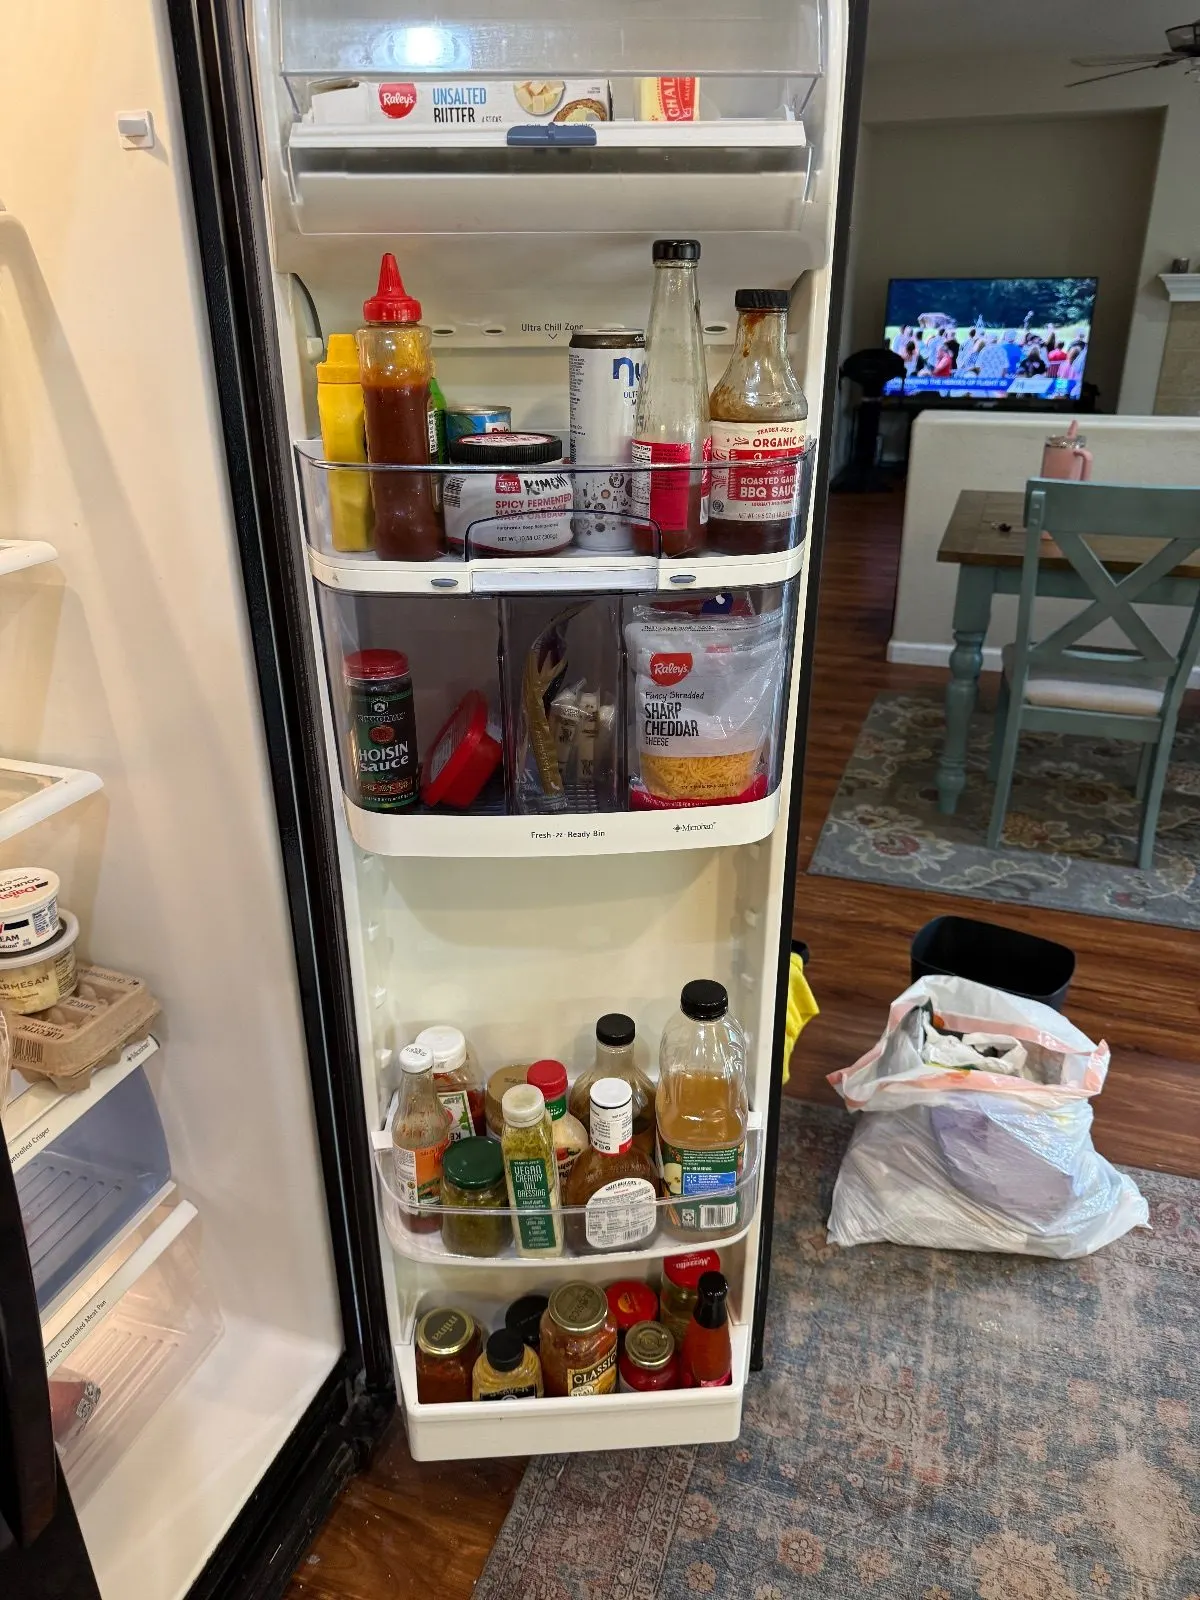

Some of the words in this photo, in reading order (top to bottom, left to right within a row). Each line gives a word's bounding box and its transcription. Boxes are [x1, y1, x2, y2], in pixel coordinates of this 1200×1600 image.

[382, 92, 415, 108] Raley's
[433, 87, 487, 106] UNSALTED
[433, 107, 476, 123] BUTTER
[521, 323, 541, 332] Ultra
[544, 323, 562, 332] Chill
[752, 436, 797, 448] ORGANIC
[741, 477, 779, 486] ROASTED
[740, 486, 767, 498] BBQ
[495, 500, 524, 509] SPICY
[527, 493, 571, 508] FERMENTED
[654, 662, 689, 676] Raley's
[645, 691, 667, 701] Fancy
[669, 691, 705, 700] Shredded
[644, 702, 682, 720] SHARP
[645, 720, 700, 737] CHEDDAR
[359, 740, 409, 762] HOISIN
[531, 831, 551, 839] Fresh
[567, 830, 591, 839] Ready
[66, 999, 97, 1012] LARGE
[31, 1127, 51, 1143] Crisper
[514, 1165, 542, 1176] VEGAN
[517, 1188, 546, 1198] DRESSING
[675, 1256, 711, 1270] Mezzetta
[60, 1319, 86, 1348] Controlled
[84, 1307, 99, 1324] Meat
[96, 1298, 107, 1313] Pan
[431, 1315, 459, 1341] mina
